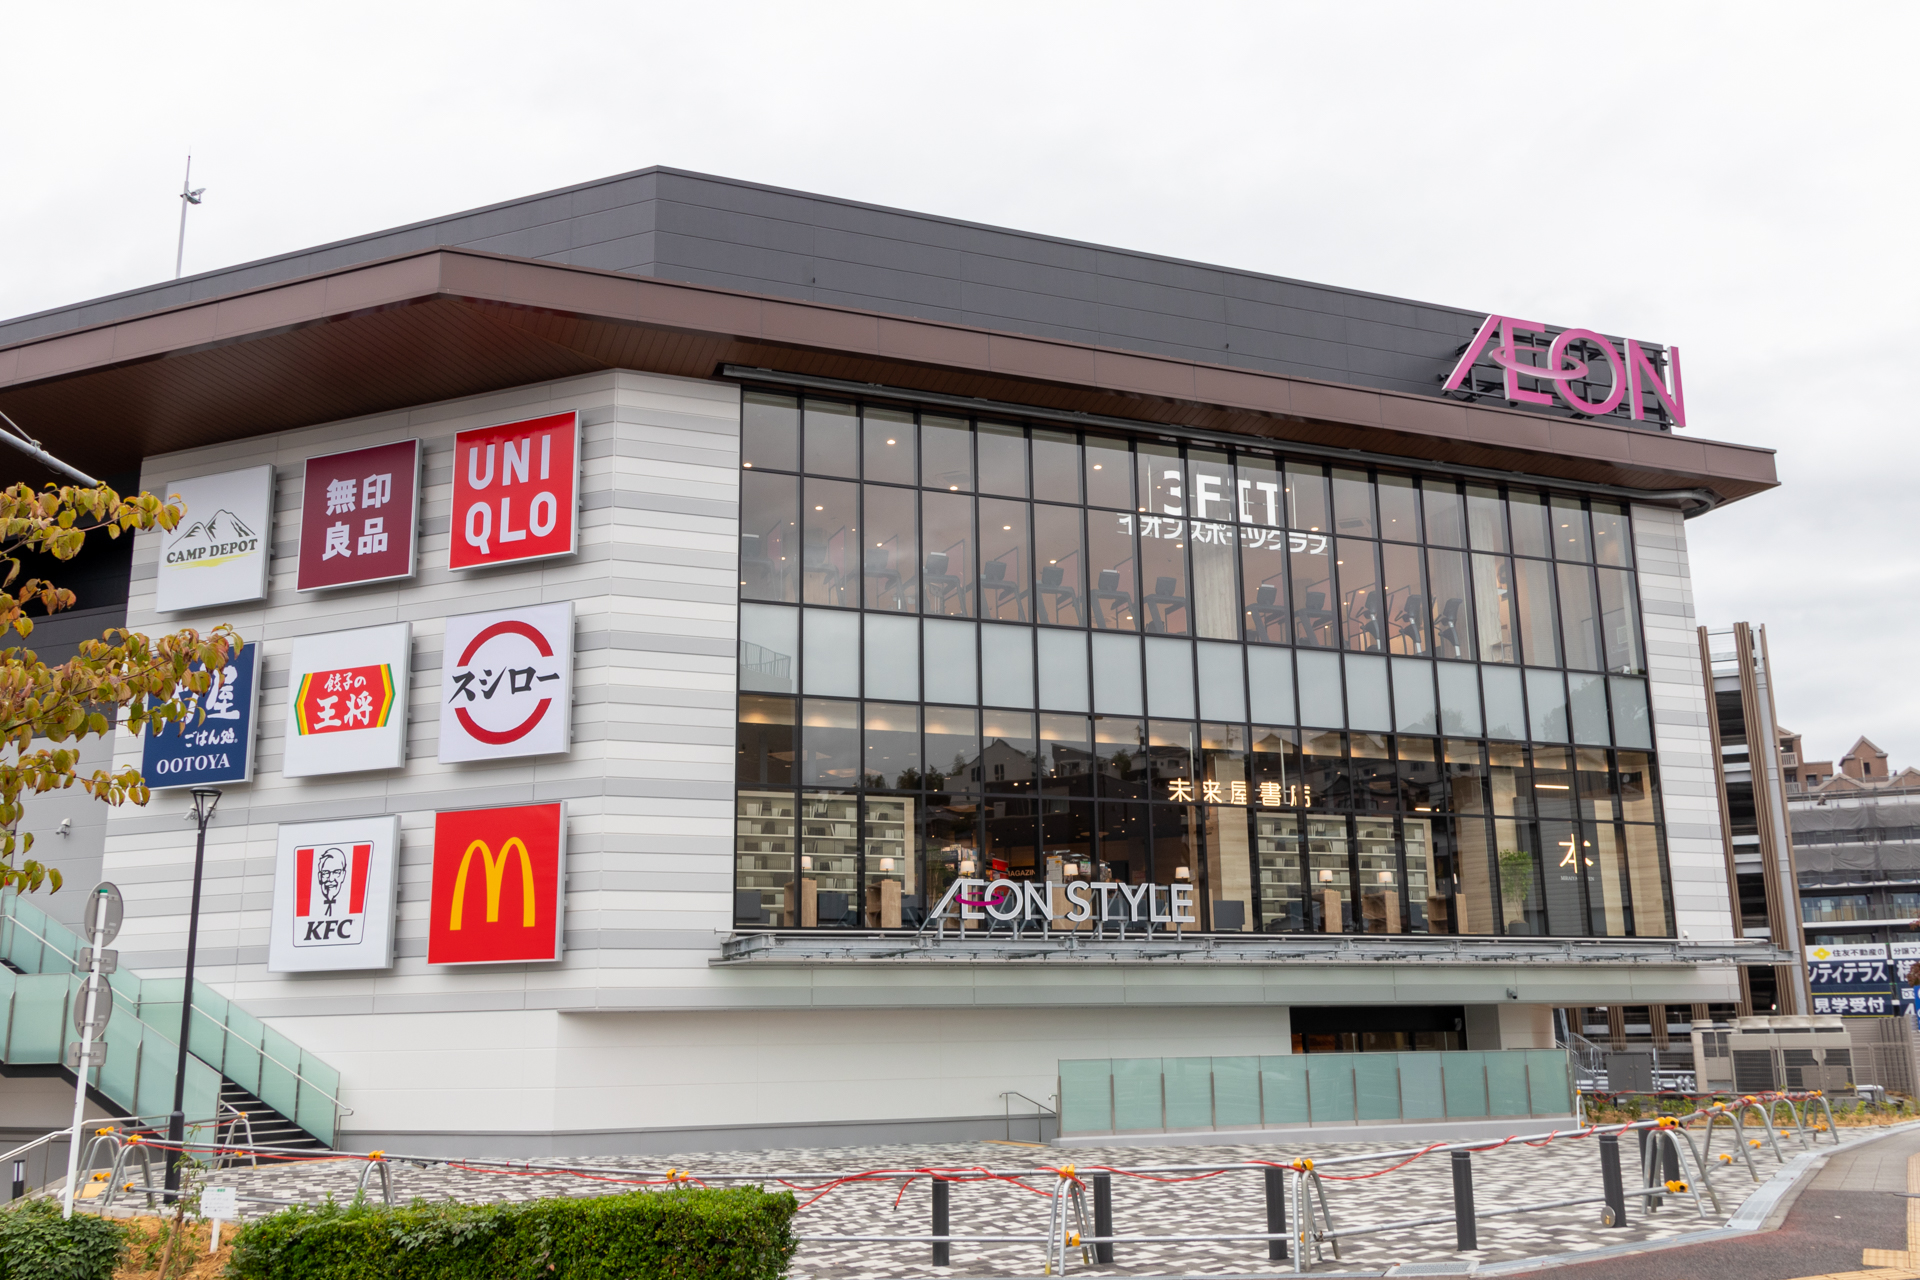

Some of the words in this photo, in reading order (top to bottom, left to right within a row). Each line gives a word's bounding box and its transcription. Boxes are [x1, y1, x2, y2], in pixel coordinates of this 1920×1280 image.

[467, 434, 552, 490] UNI
[325, 472, 392, 516] 無印
[322, 516, 389, 562] 良品
[464, 491, 558, 555] QLO
[166, 546, 207, 564] CAMP
[208, 538, 258, 557] DEPOT
[324, 671, 367, 692] 餃子の
[448, 665, 560, 704] スシロー
[313, 690, 373, 730] 王将
[184, 727, 236, 748] ごはん処
[156, 752, 231, 775] OOTOYA
[1066, 880, 1196, 923] STYLE
[303, 918, 353, 941] KFC
[1814, 996, 1885, 1014] 見学受付
